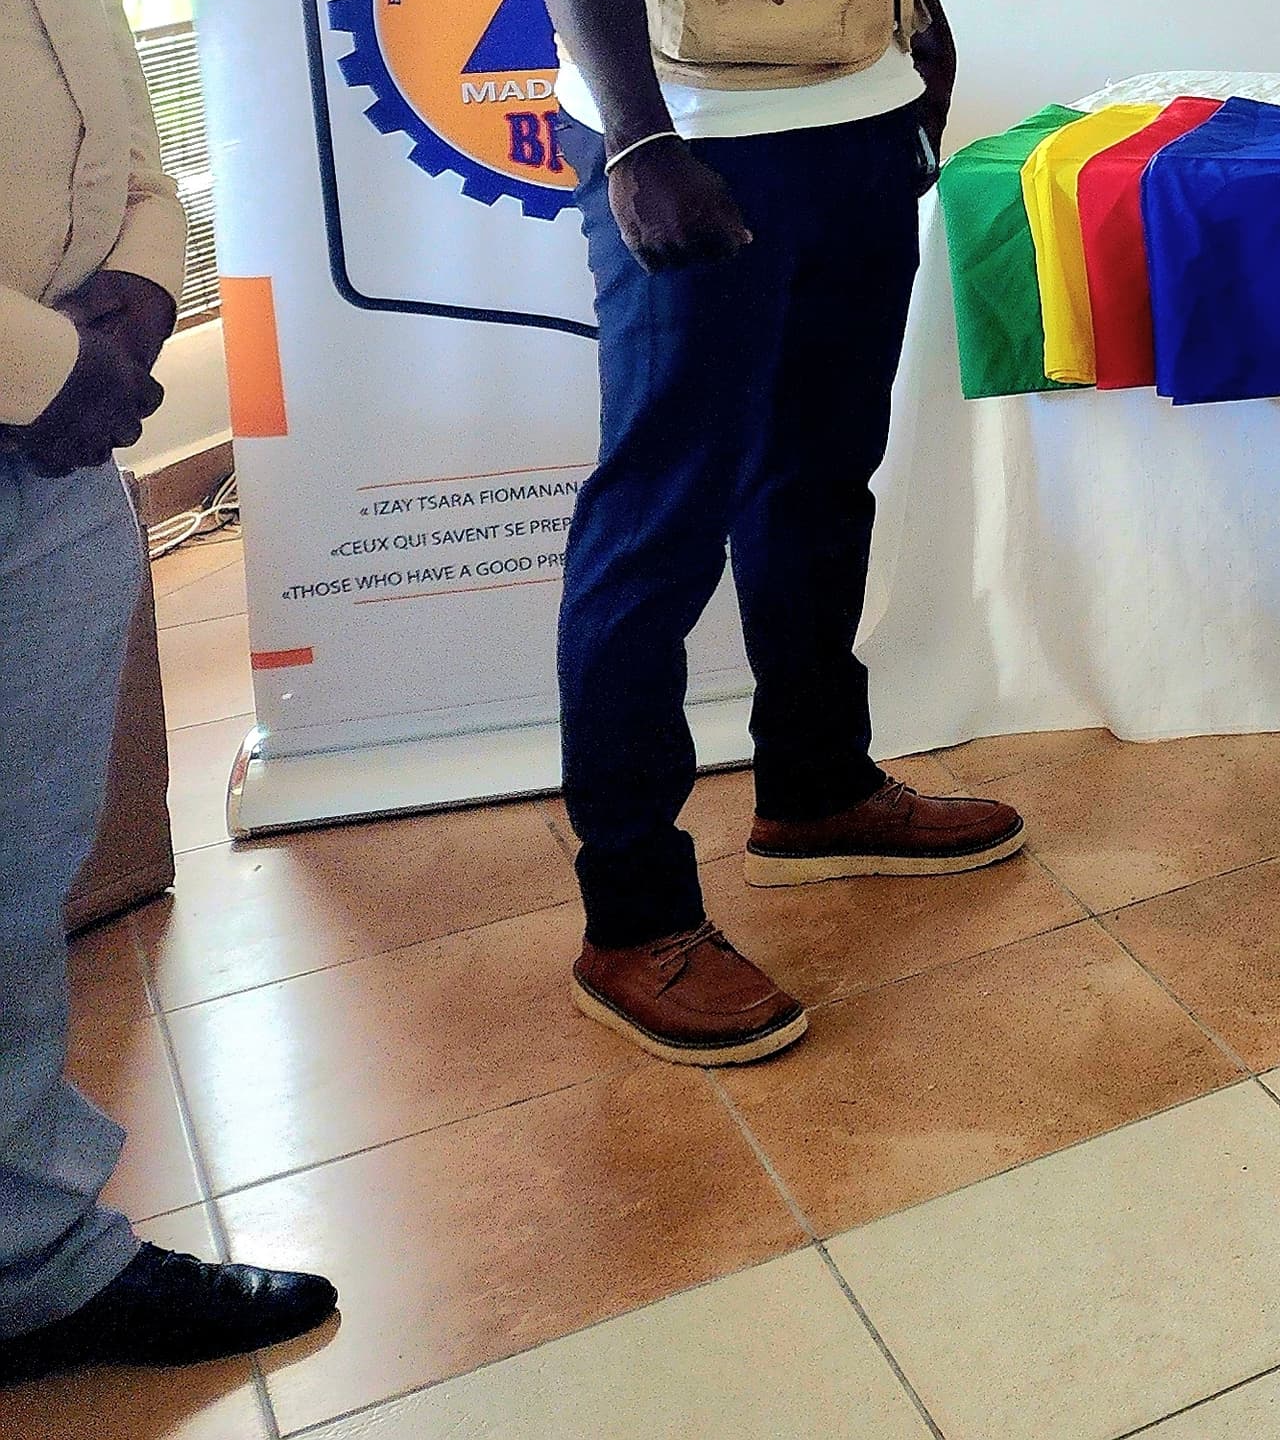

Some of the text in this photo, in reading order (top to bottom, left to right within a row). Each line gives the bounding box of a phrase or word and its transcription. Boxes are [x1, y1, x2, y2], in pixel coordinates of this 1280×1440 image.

[374, 499, 413, 515] IZAY
[418, 493, 475, 511] TSARA
[480, 481, 578, 504] FIOMANAN
[393, 533, 427, 550] QUI
[432, 525, 500, 545] SAVENT
[504, 522, 526, 537] SE
[355, 572, 402, 589] WHO
[407, 566, 454, 584] HAVE
[460, 565, 472, 578] A
[476, 557, 532, 576] GOOD
